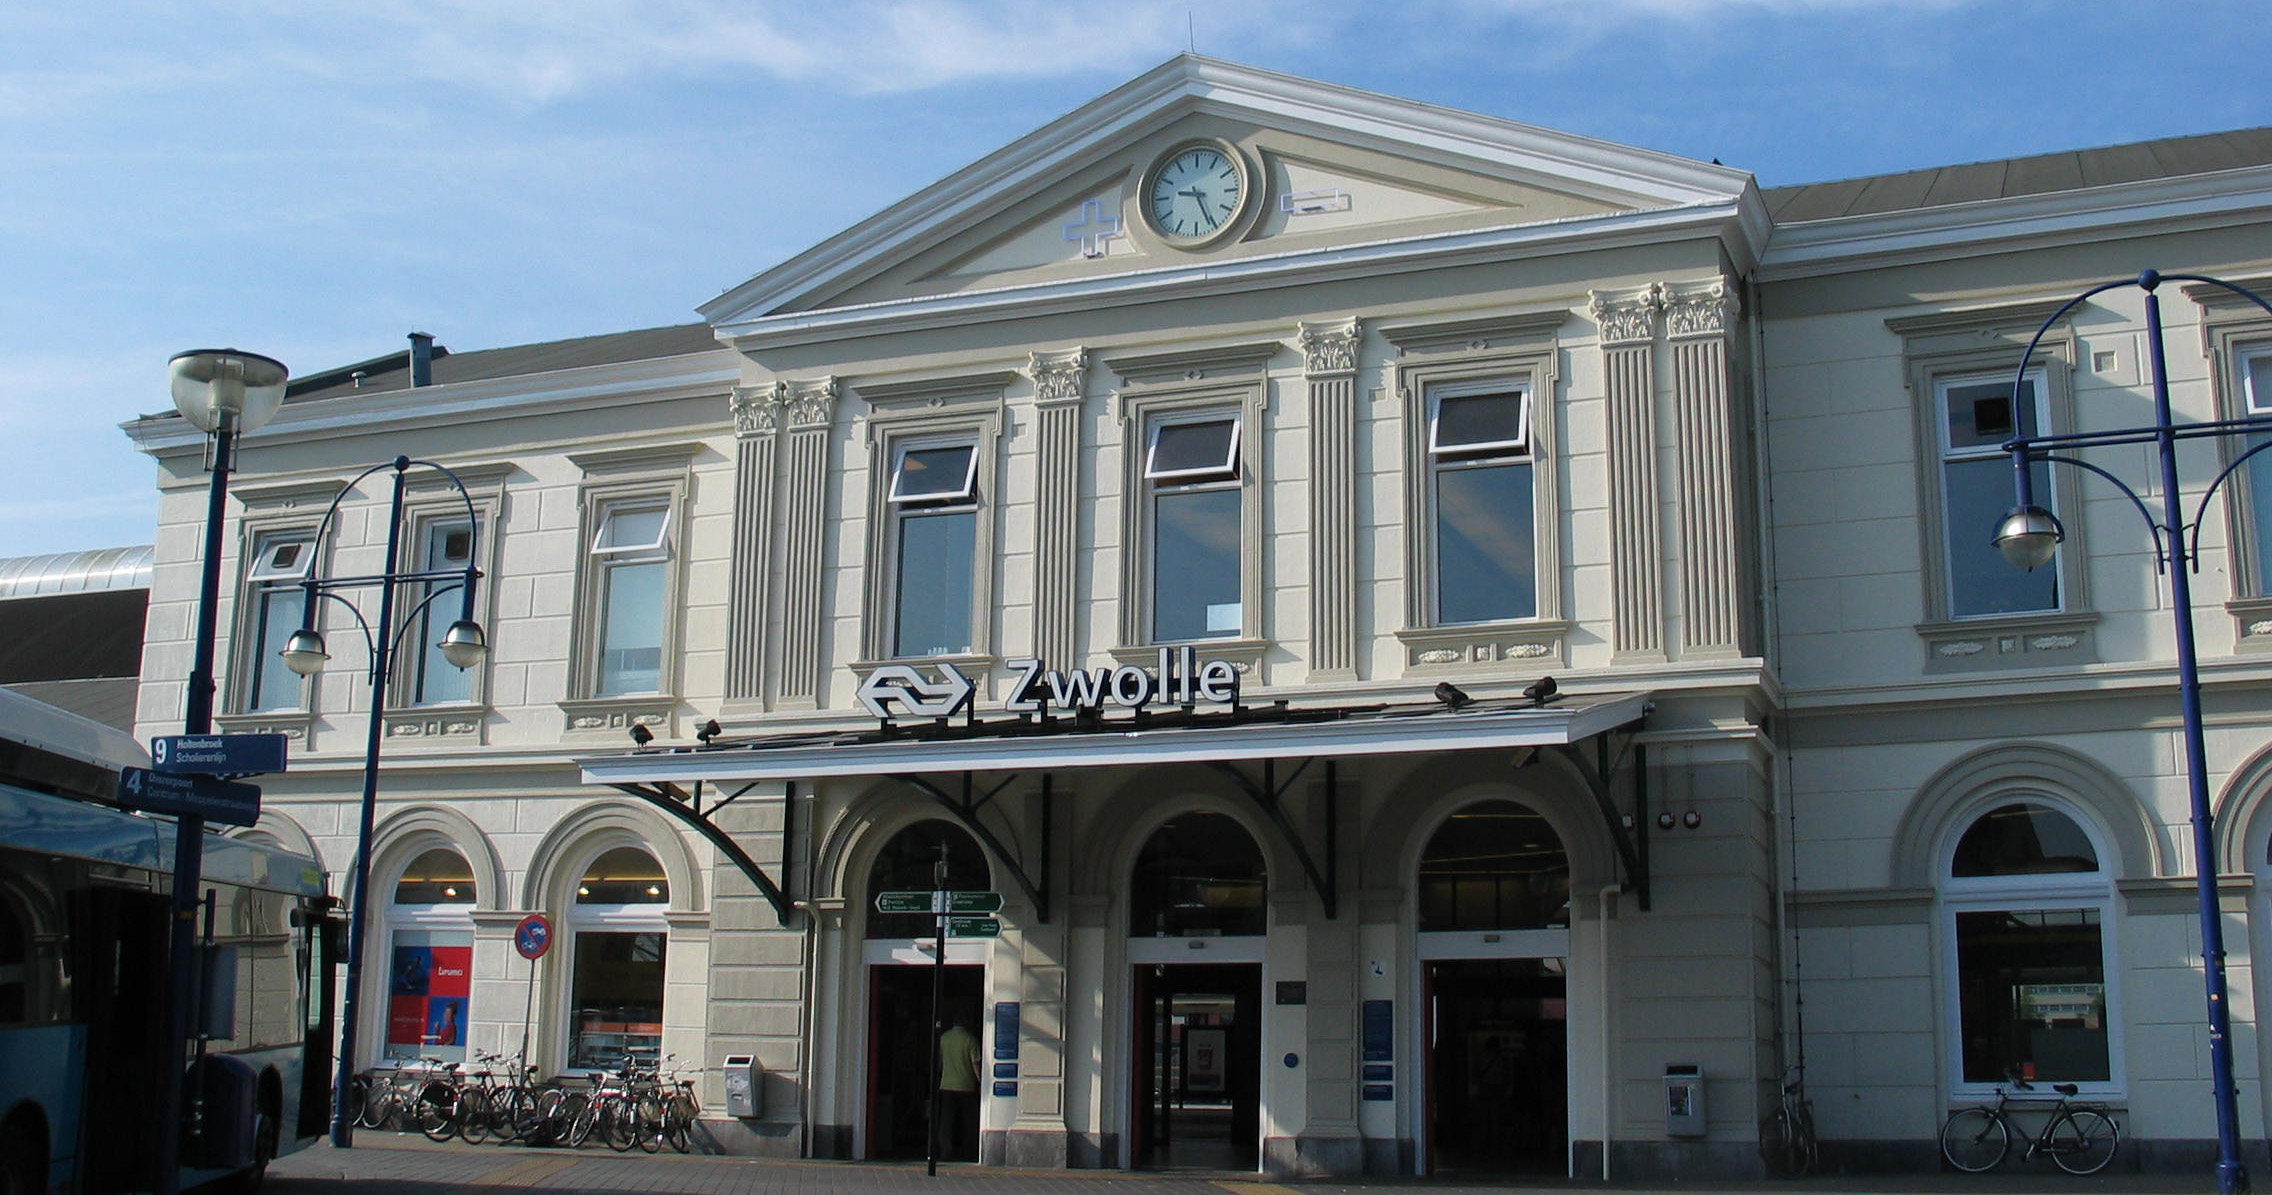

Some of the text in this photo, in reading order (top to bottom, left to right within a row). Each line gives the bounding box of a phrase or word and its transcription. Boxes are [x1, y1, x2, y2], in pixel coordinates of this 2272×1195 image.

[1005, 646, 1240, 713] Zwolle
[155, 738, 167, 764] 9
[176, 738, 223, 749] Holtenbroek
[176, 751, 226, 764] Scholierenlijn
[126, 769, 142, 795] 4
